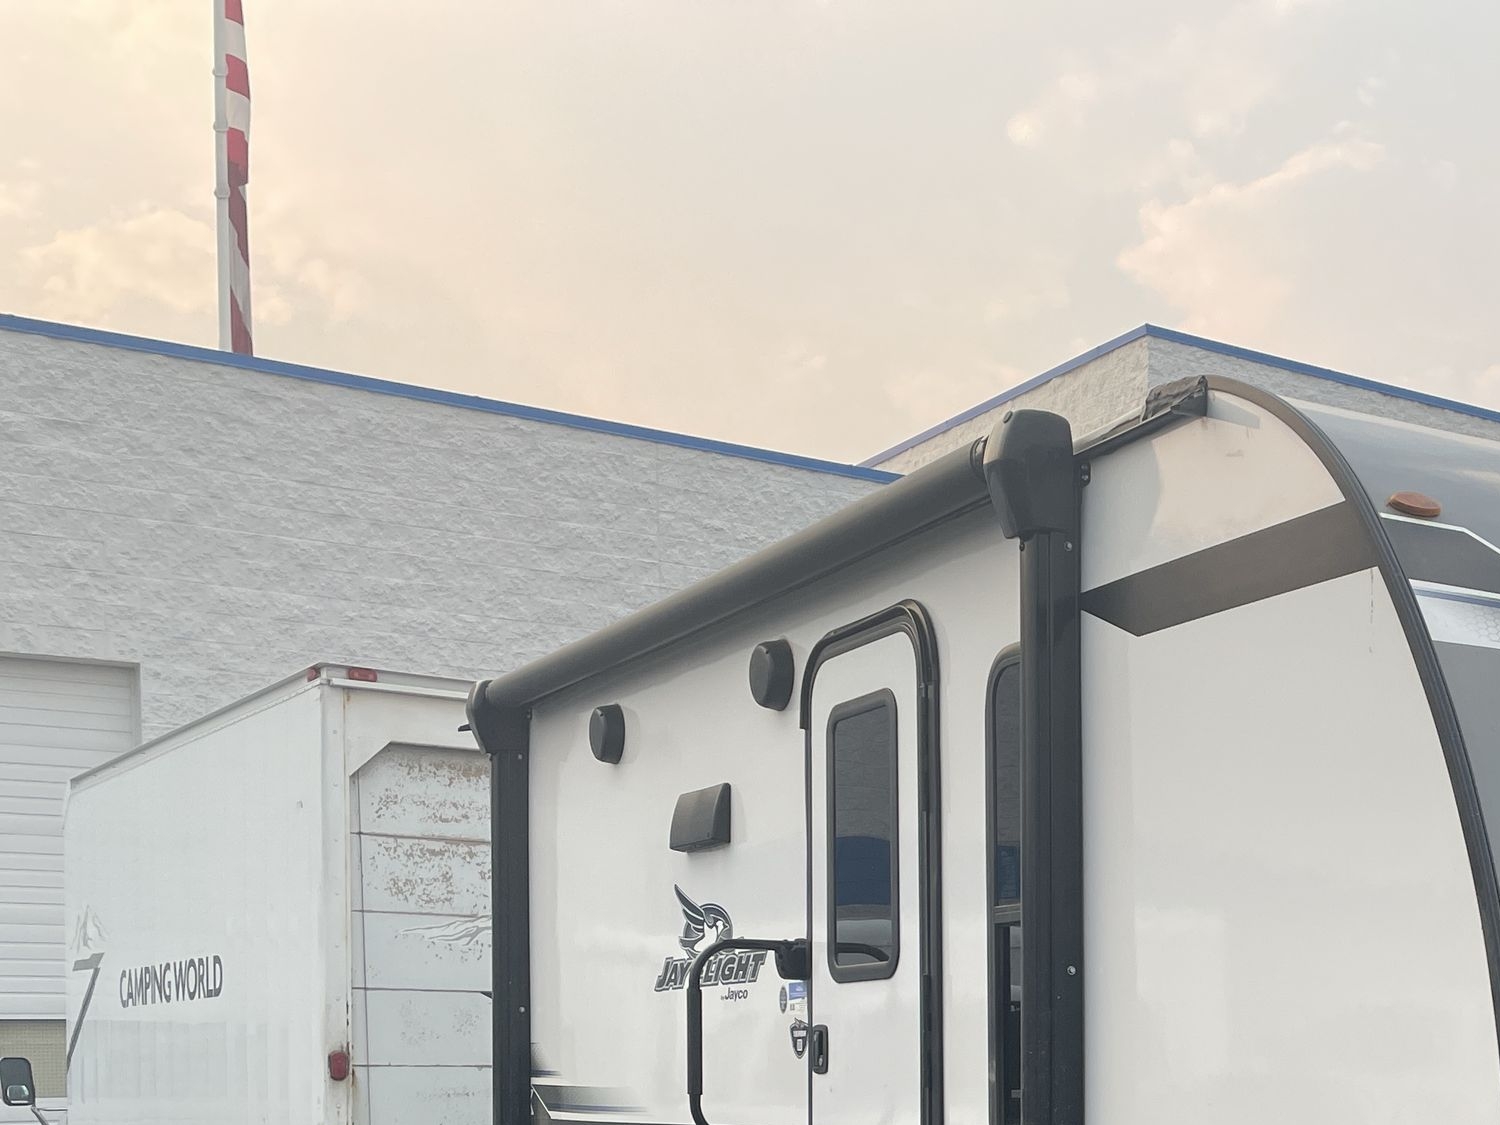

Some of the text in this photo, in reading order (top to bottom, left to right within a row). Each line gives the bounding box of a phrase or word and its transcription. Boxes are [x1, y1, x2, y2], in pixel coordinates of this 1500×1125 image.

[120, 955, 222, 1008] CAMPING WORLD
[654, 956, 694, 992] JAY
[699, 950, 767, 987] LIGHT
[725, 987, 748, 1002] Jayco
